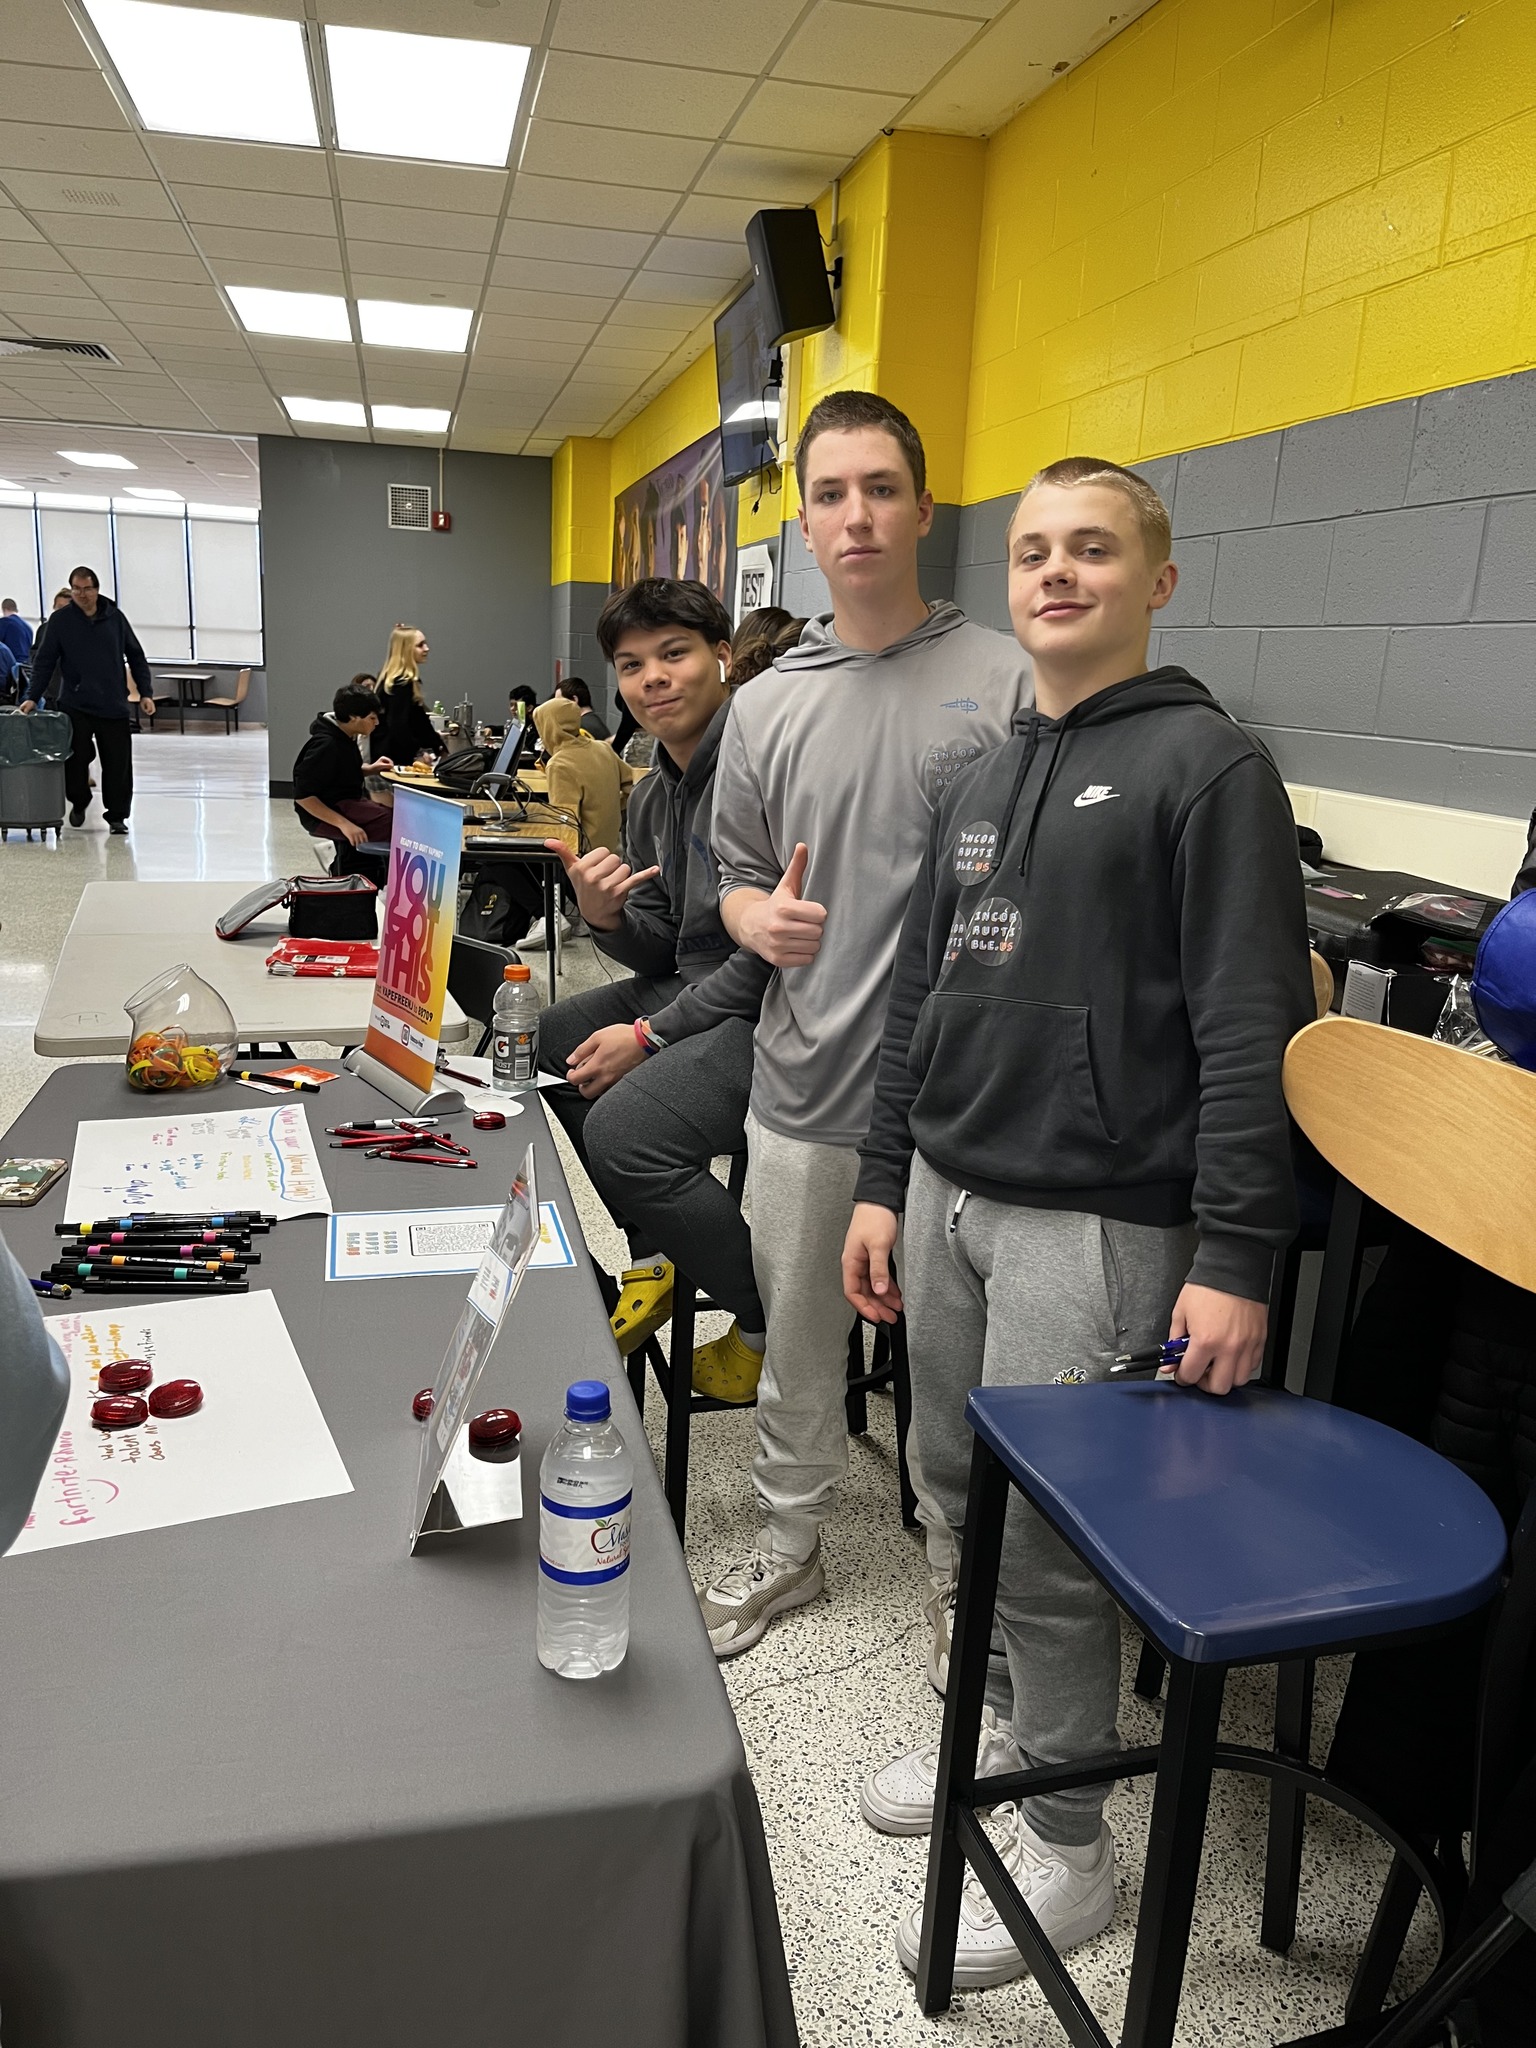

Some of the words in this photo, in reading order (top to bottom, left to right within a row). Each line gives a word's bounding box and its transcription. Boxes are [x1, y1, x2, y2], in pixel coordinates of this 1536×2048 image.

[741, 573, 765, 607] EST
[1081, 785, 1113, 799] NIKE
[395, 847, 446, 906] YOU
[388, 899, 441, 952] GOT
[382, 933, 433, 1004] THIS
[495, 1035, 510, 1058] G
[117, 1434, 141, 1464] talent
